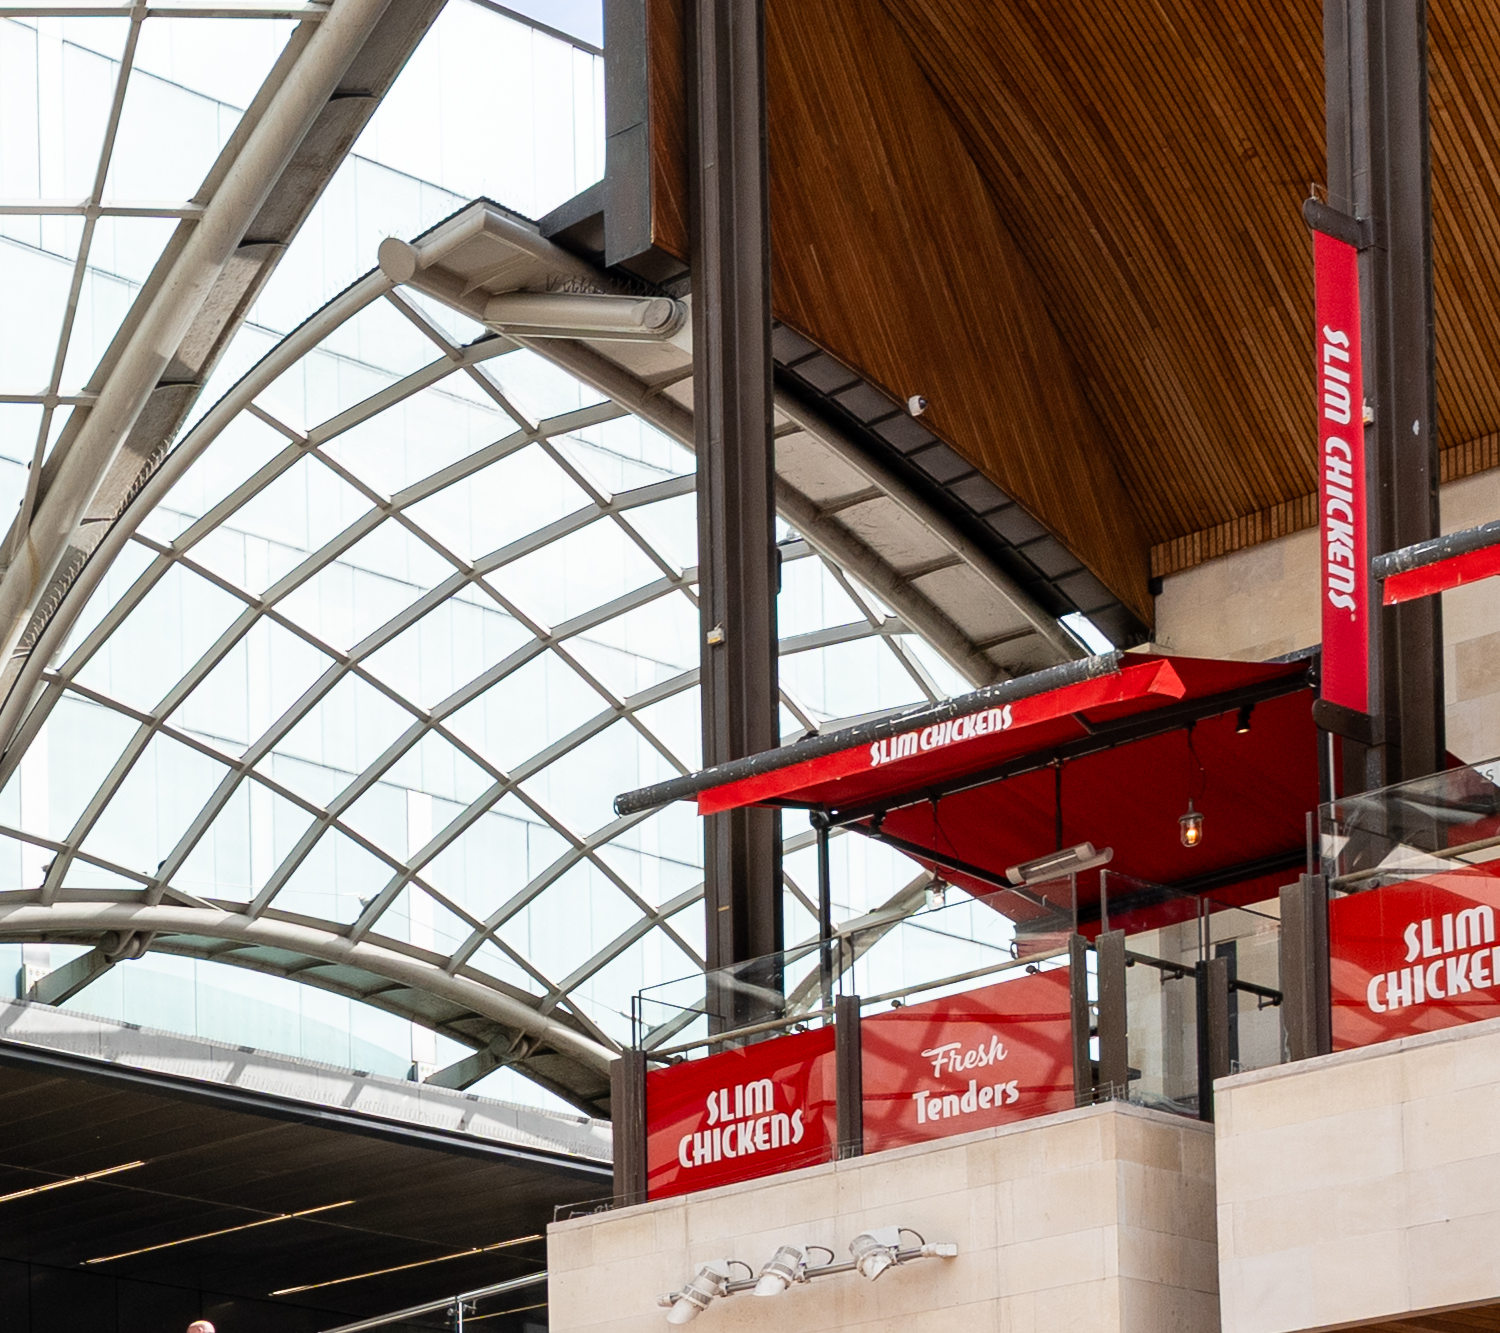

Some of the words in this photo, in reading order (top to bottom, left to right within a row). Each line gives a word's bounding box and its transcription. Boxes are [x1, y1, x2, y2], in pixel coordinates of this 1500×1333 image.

[1323, 324, 1351, 425] SLIM
[1325, 436, 1357, 612] CHICKENS
[870, 732, 919, 766] SLIM
[920, 704, 1013, 750] CHICKENS
[1403, 904, 1495, 963] SLIM
[921, 1035, 1007, 1078] Fresh
[706, 1078, 774, 1126] SLIM
[912, 1079, 1019, 1124] Tenders
[679, 1108, 804, 1169] CHICKENS
